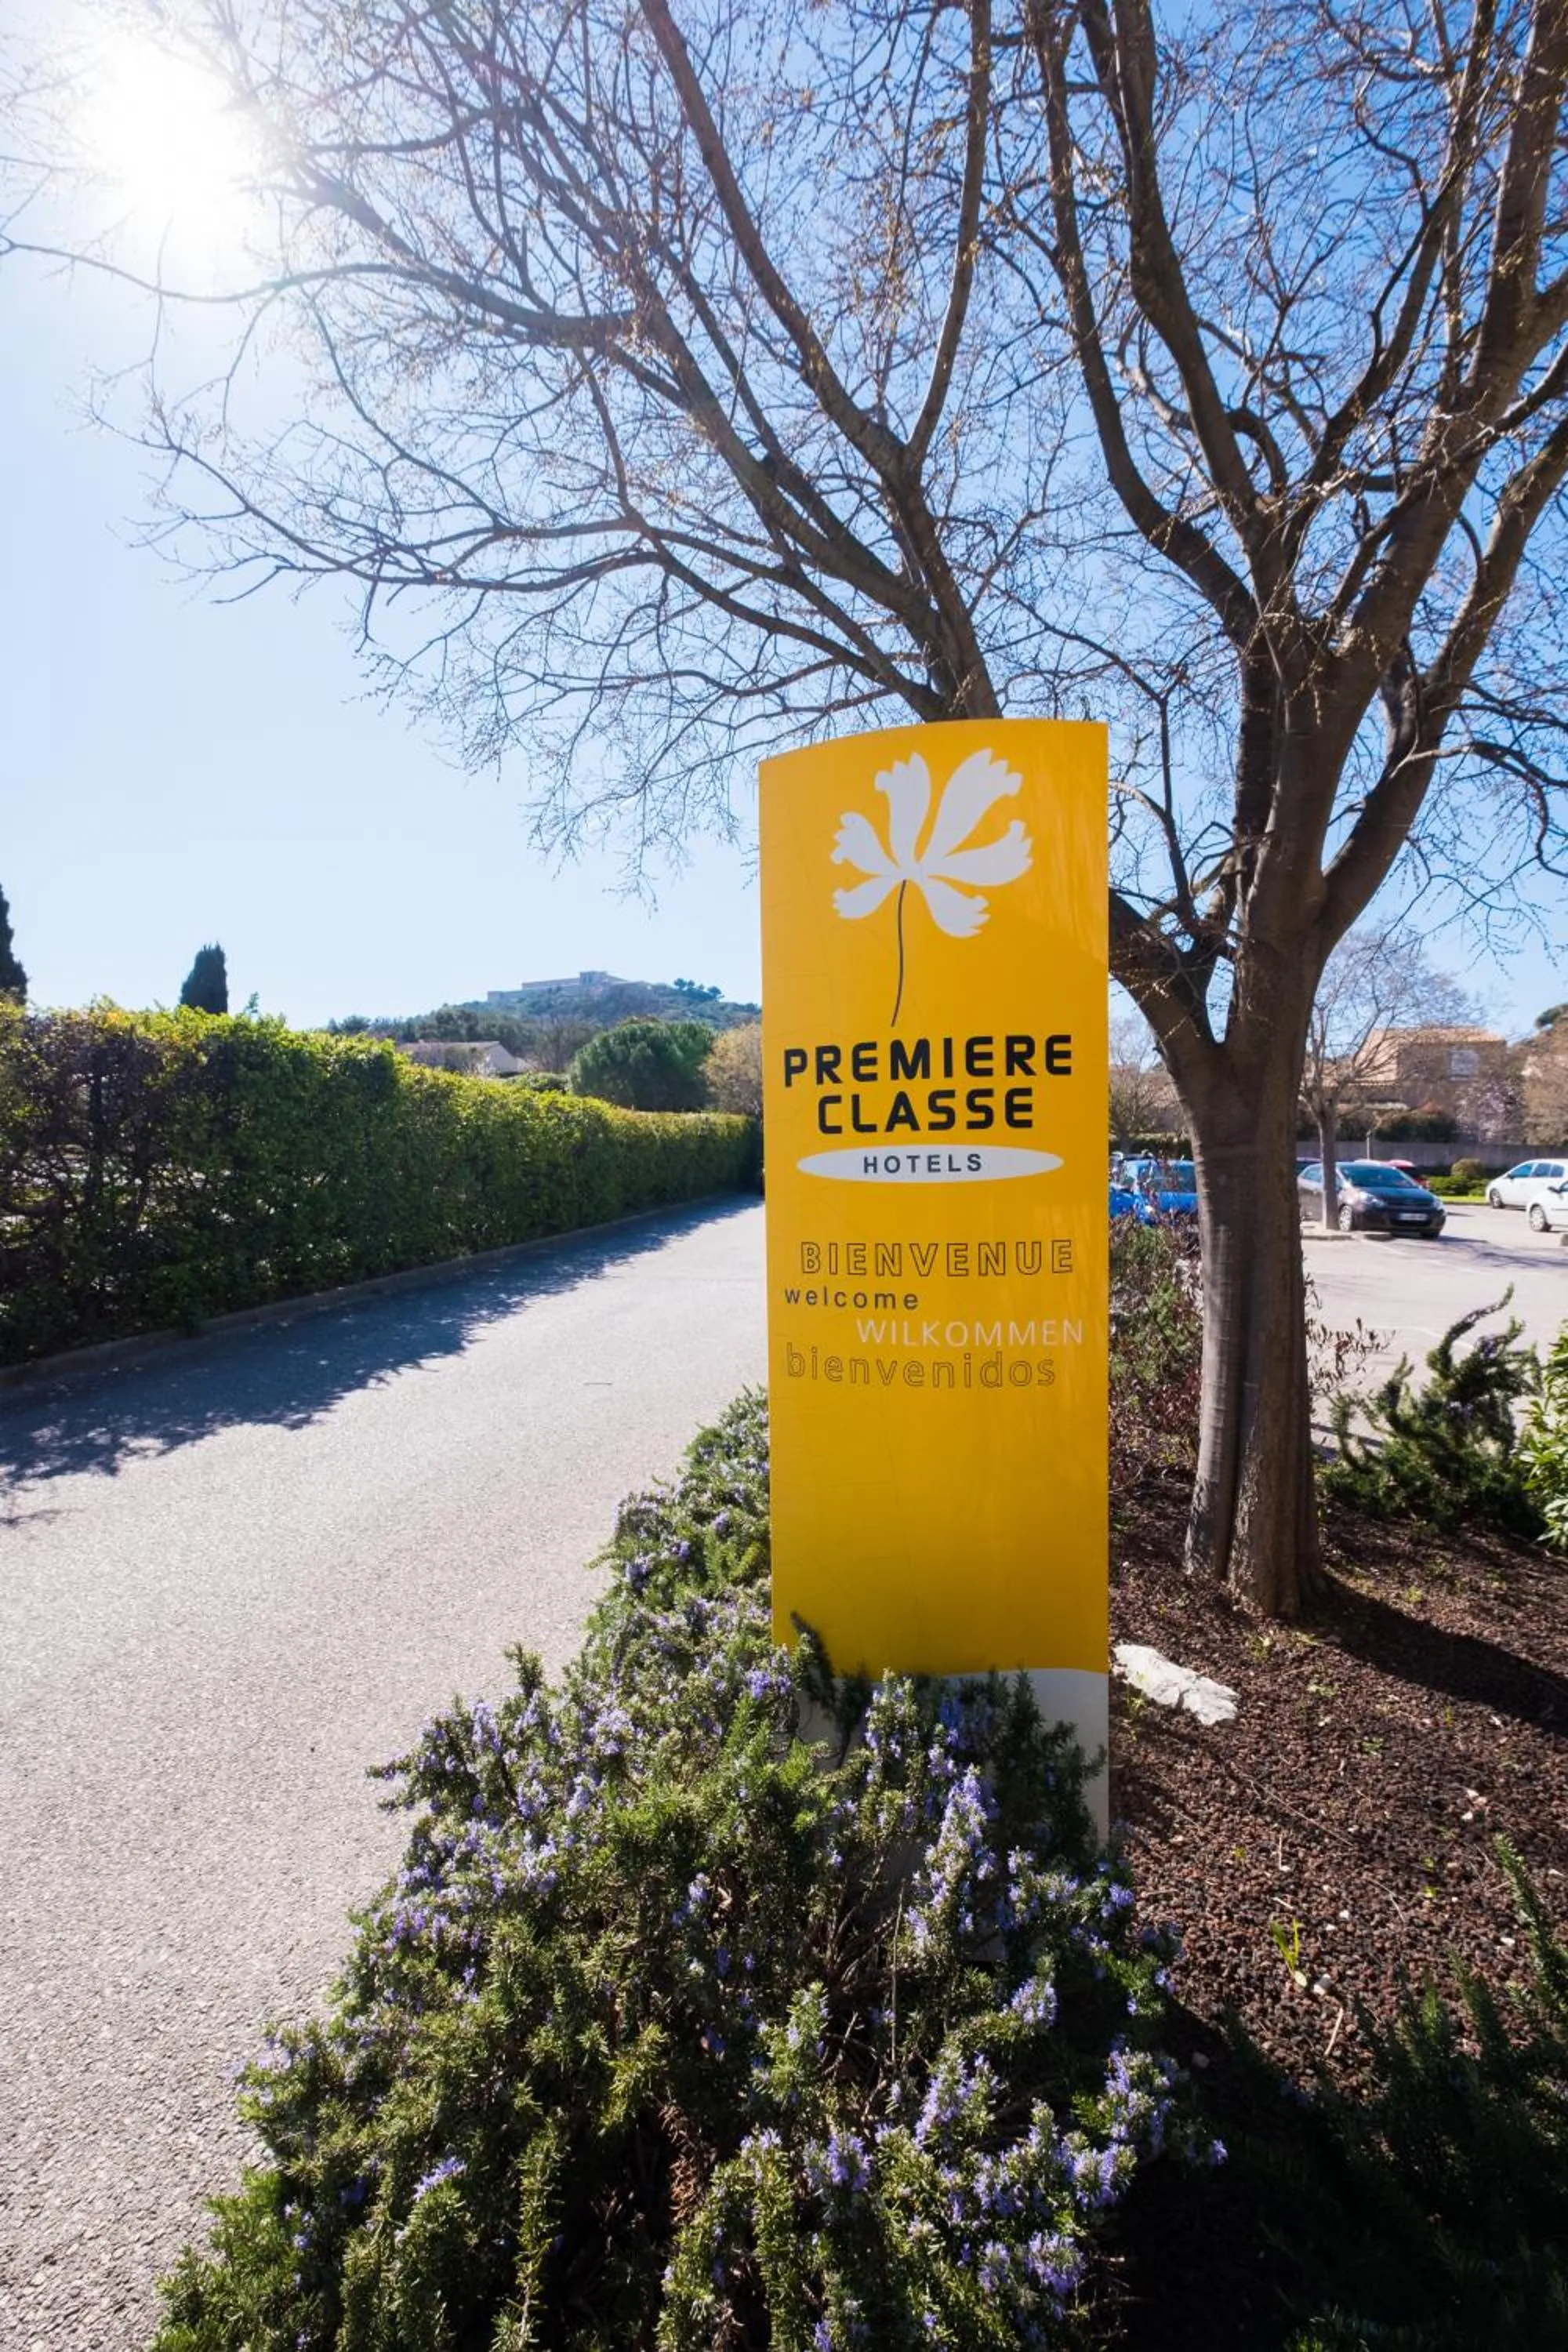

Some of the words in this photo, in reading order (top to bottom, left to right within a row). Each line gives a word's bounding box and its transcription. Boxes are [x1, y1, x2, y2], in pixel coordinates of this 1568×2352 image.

[784, 1035, 1072, 1087] PREMIERE
[818, 1087, 1033, 1134] CLASSE
[863, 1153, 982, 1174] HOTELS
[800, 1240, 1073, 1277] BIENVENUE
[785, 1287, 919, 1310] welcome
[856, 1319, 1083, 1348] WILKOMMEN
[786, 1342, 1055, 1388] bienvenidos
